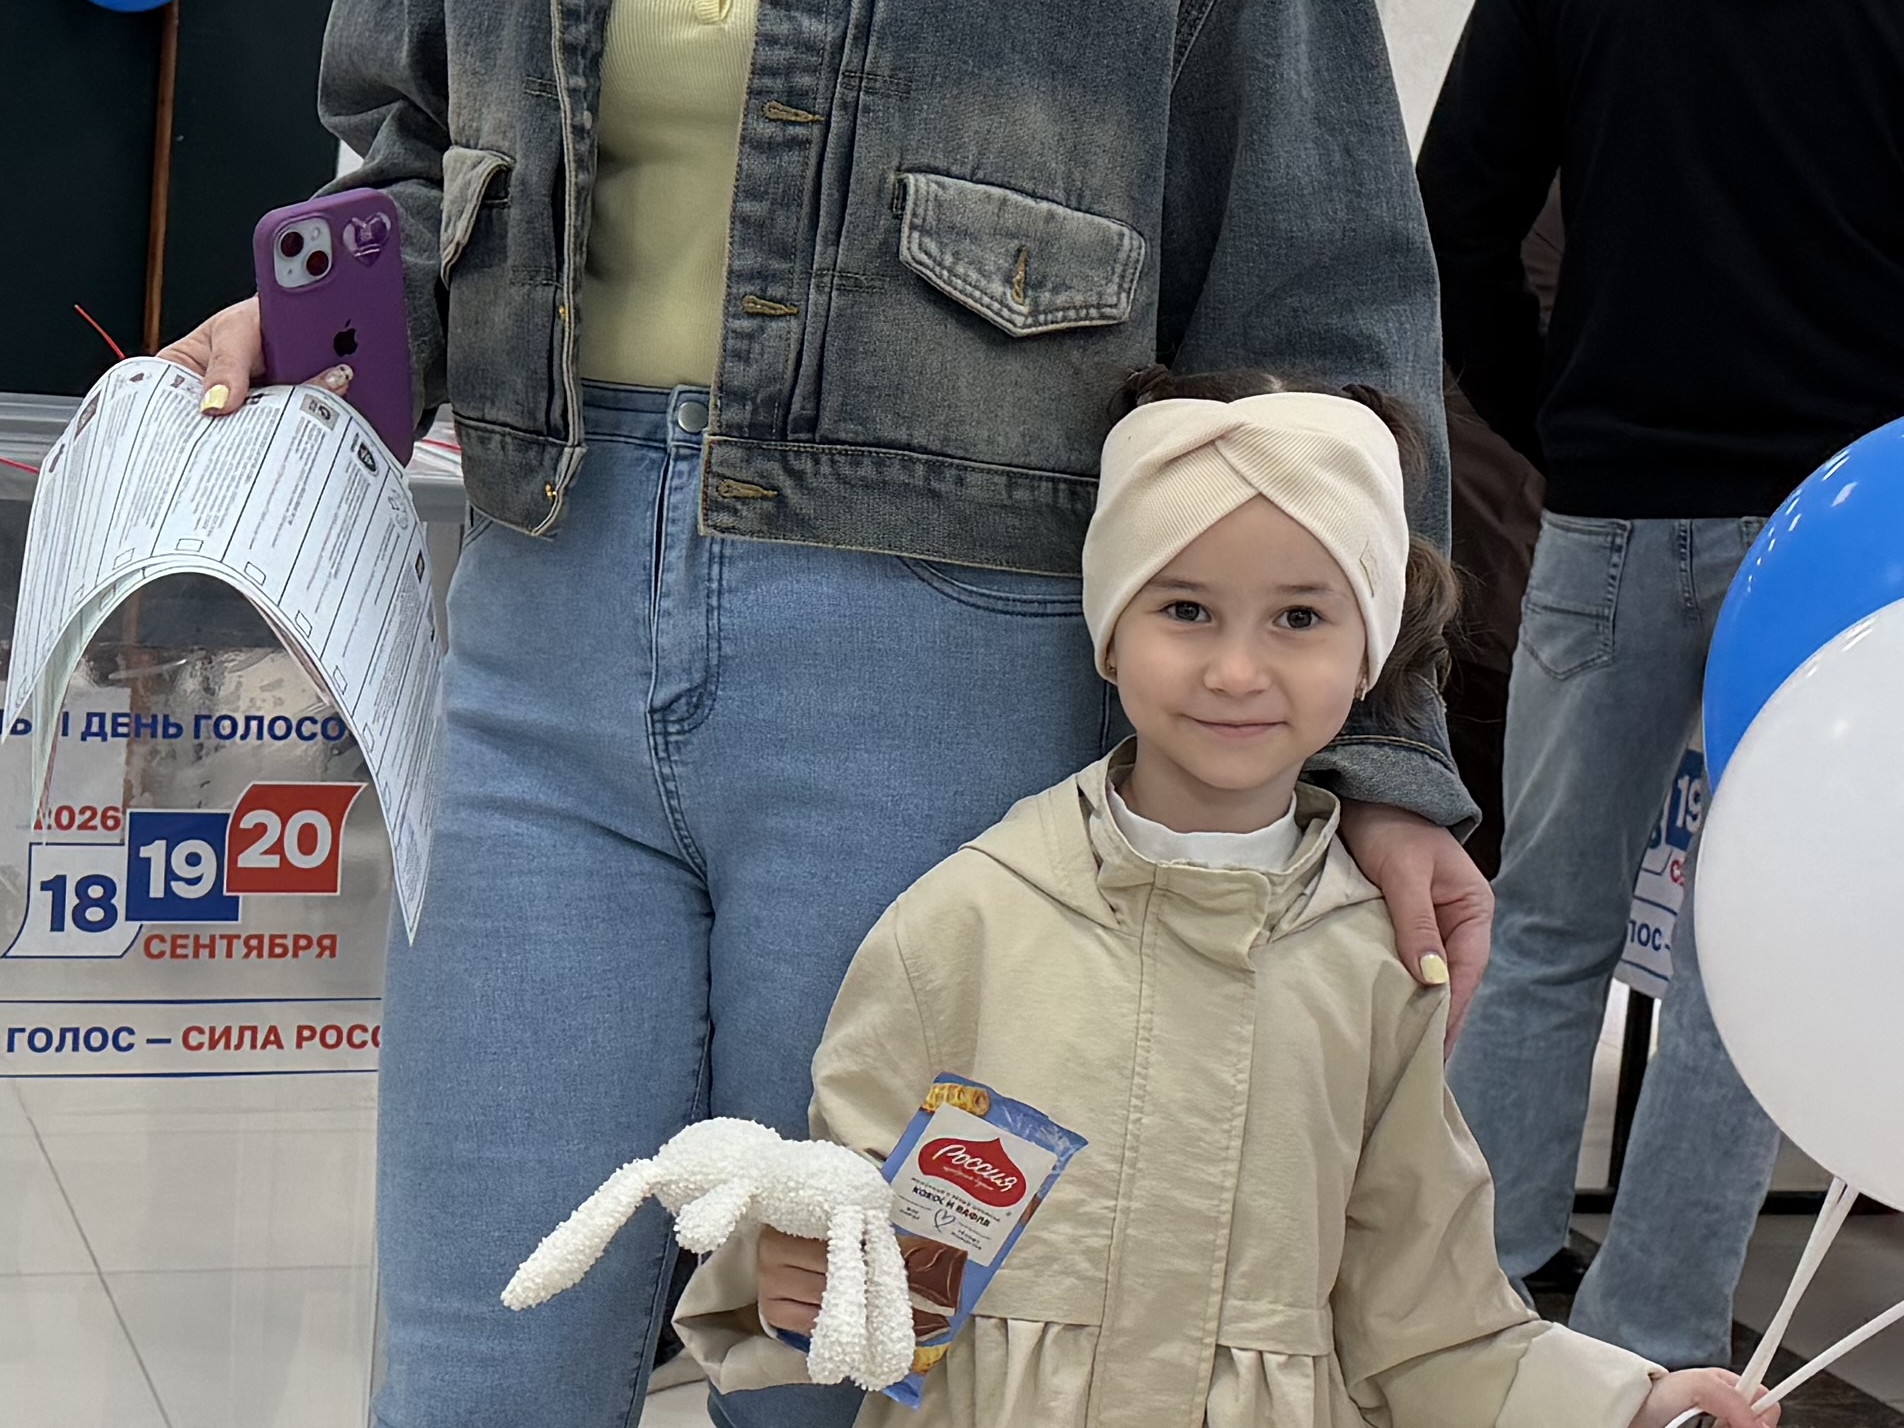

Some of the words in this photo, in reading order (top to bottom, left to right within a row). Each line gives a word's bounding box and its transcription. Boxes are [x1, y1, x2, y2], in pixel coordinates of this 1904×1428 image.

[80, 711, 184, 741] ДЕНЬ
[195, 713, 347, 742] ГОЛОСО
[236, 809, 332, 869] 20
[139, 839, 217, 899] 19
[39, 874, 118, 933] 18
[143, 933, 338, 960] СЕНТЯБРЯ
[6, 1027, 136, 1053] ГОЛОС
[181, 1025, 281, 1052] СИЛА
[932, 1144, 1017, 1192] Россия
